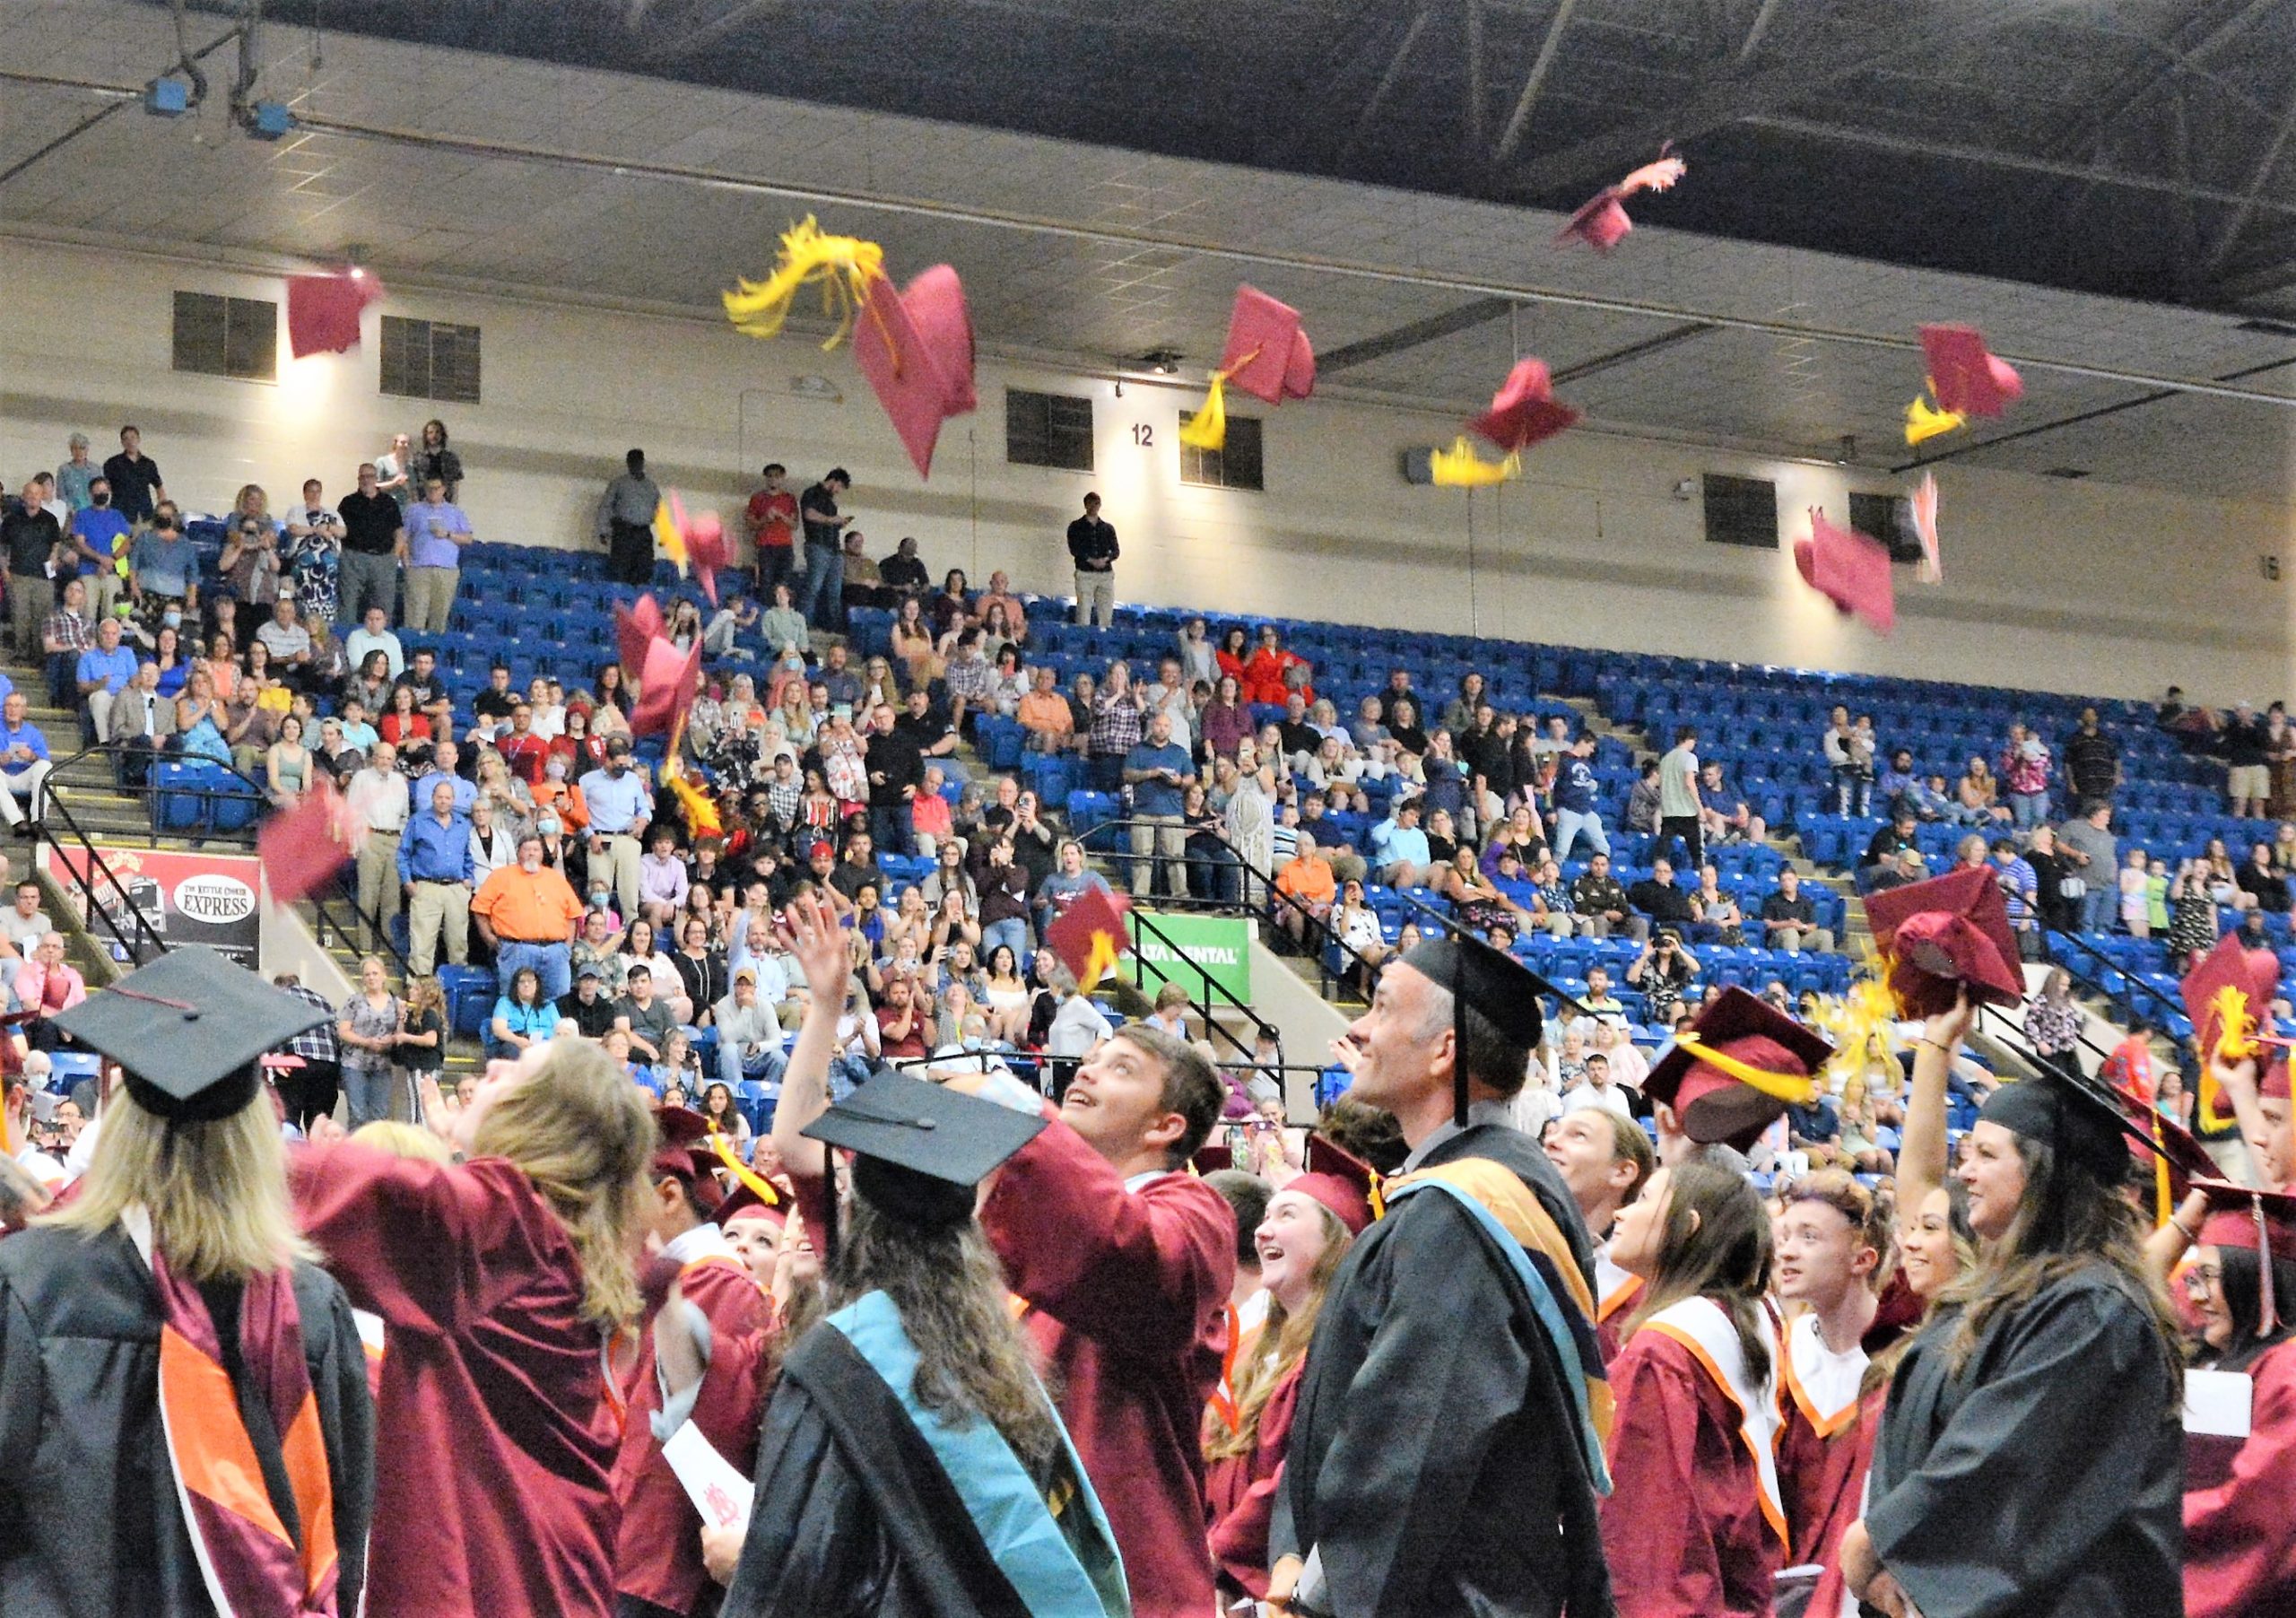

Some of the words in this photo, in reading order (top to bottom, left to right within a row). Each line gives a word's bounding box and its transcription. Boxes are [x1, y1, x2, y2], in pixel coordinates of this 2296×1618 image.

[1132, 422, 1152, 447] 12
[197, 884, 222, 895] KETTLE
[184, 893, 248, 917] EXPRESS
